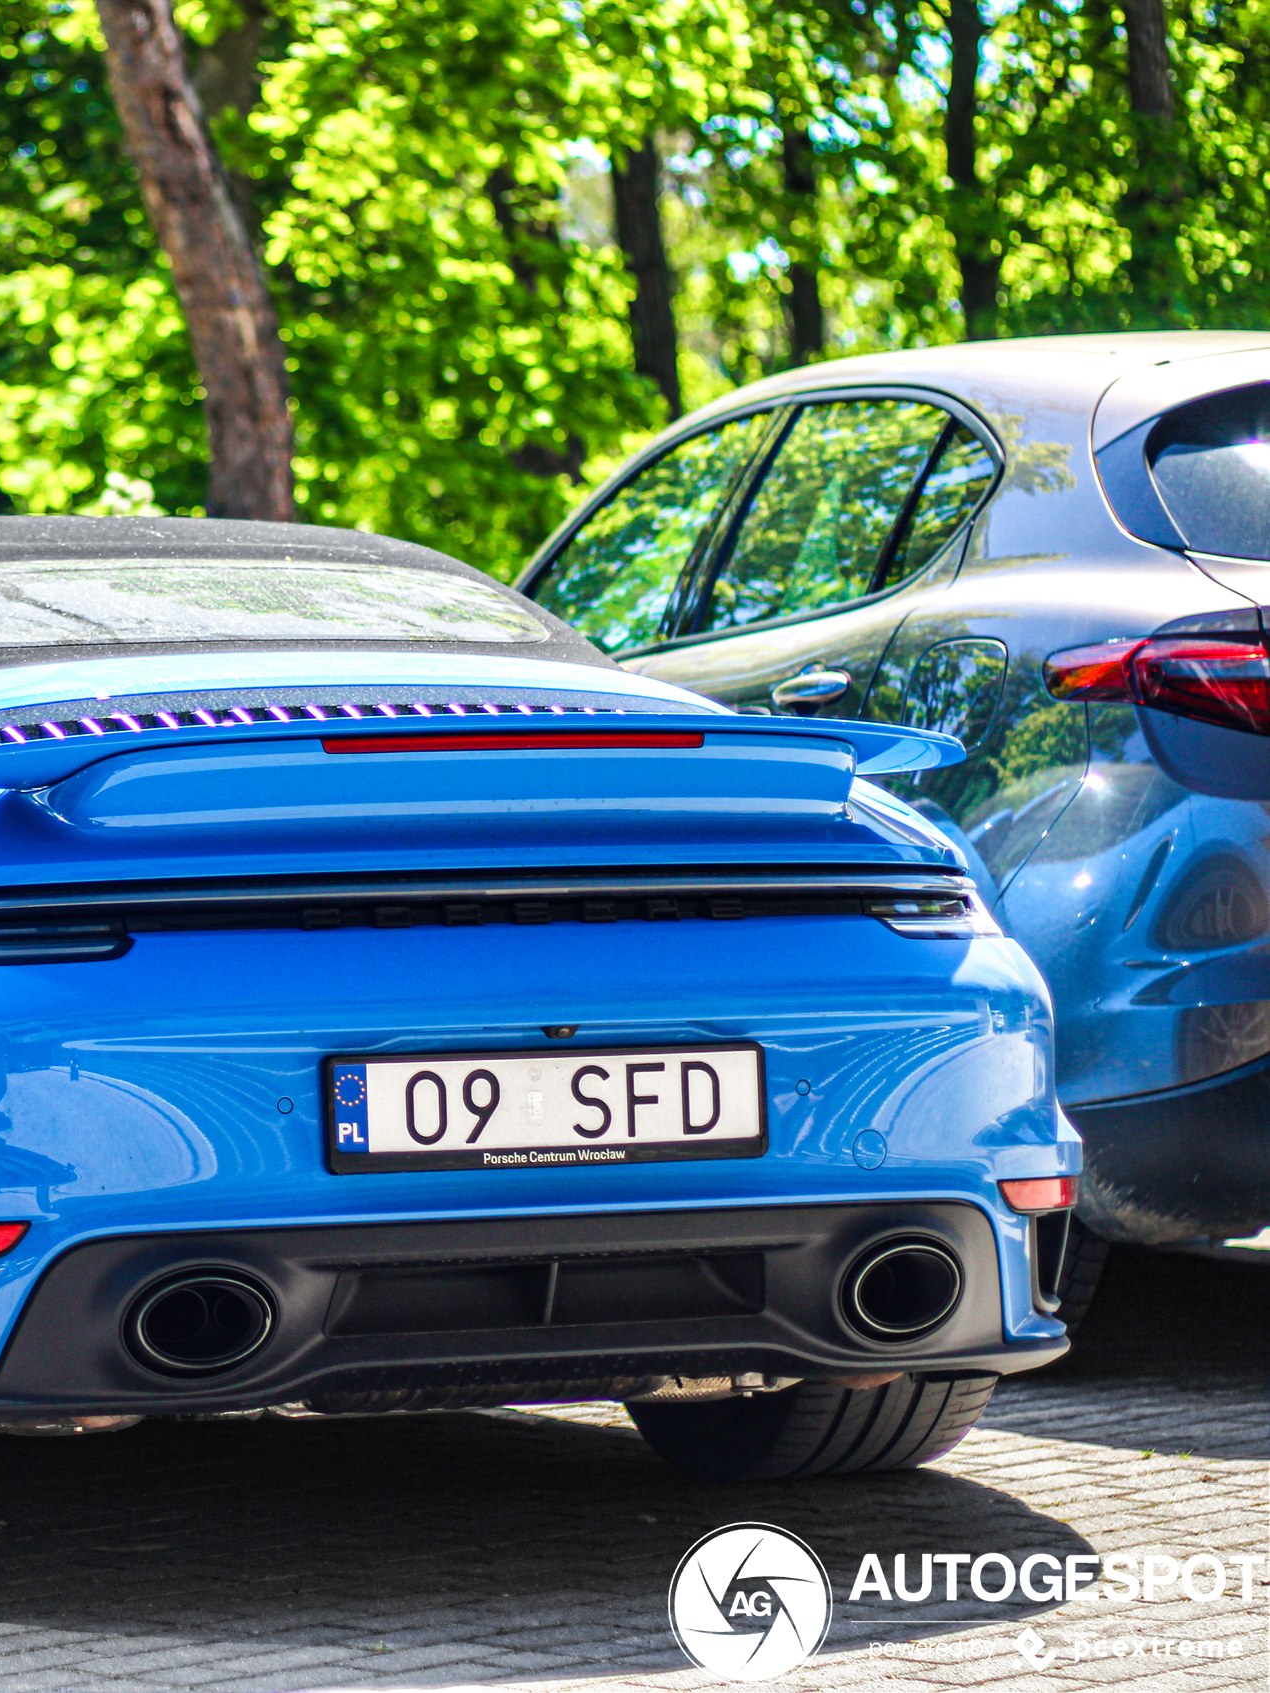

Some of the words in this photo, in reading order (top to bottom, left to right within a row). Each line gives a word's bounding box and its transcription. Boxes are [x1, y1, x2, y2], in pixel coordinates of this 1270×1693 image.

[405, 1069, 500, 1145] 09
[570, 1060, 721, 1139] SFD
[338, 1123, 364, 1143] PL
[483, 1152, 528, 1165] Porsche
[529, 1150, 577, 1163] Centrum
[577, 1148, 626, 1161] Wrocław
